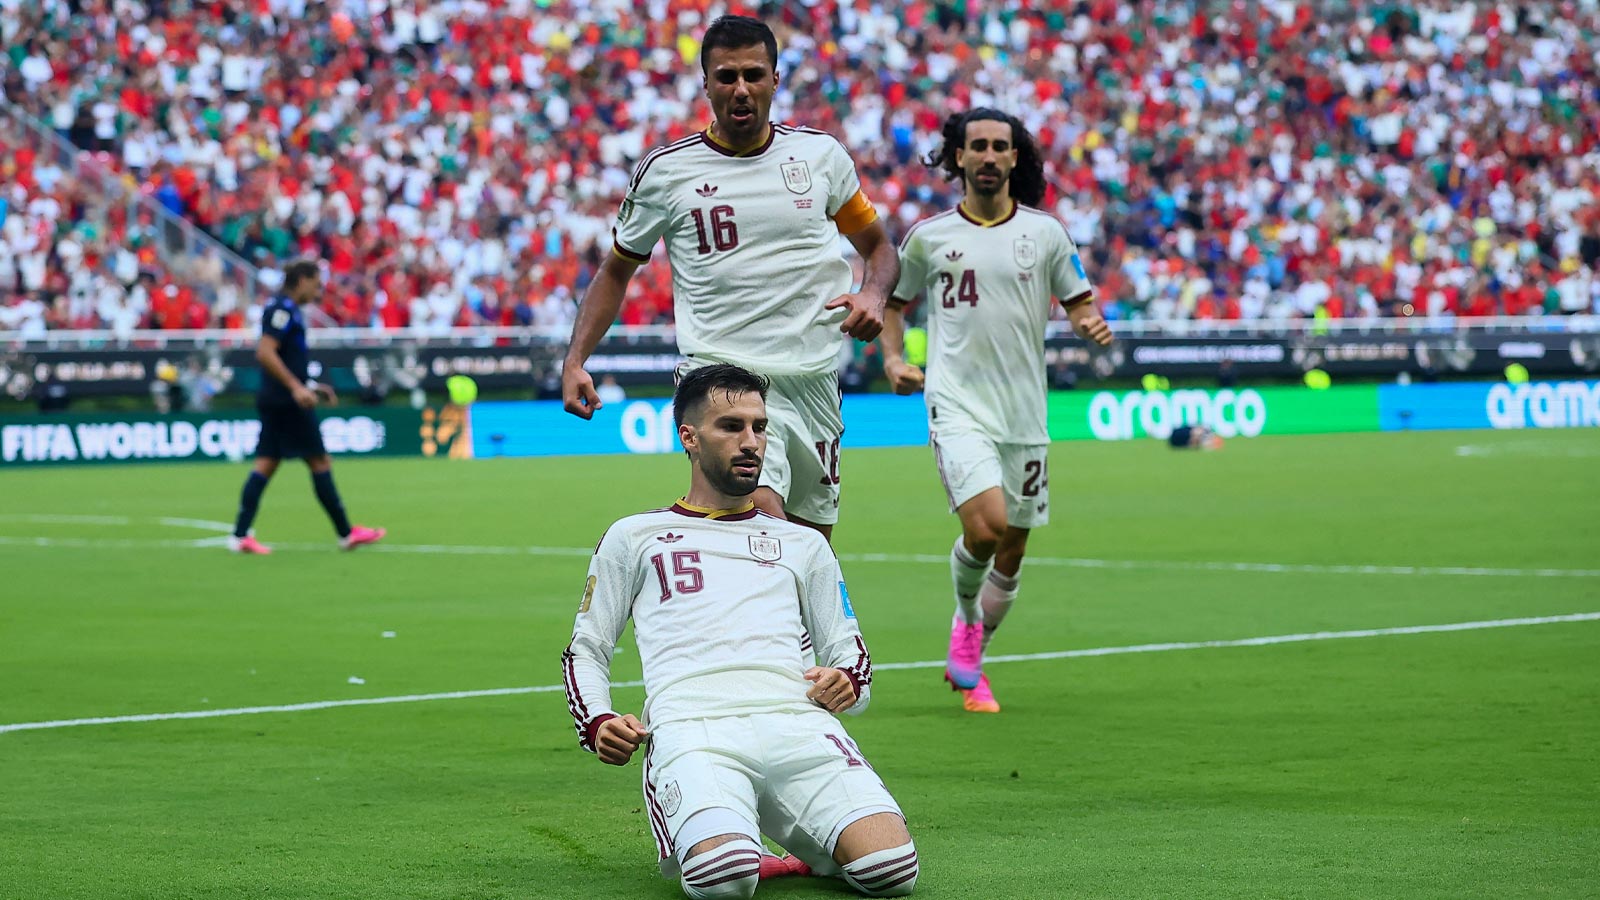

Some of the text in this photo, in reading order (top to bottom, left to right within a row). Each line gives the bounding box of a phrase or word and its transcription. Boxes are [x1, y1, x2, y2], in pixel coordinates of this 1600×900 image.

[690, 204, 739, 255] 16
[940, 269, 979, 309] 24
[1089, 388, 1267, 441] aramco
[1486, 381, 1600, 430] aram
[3, 424, 77, 461] FIFA
[76, 421, 197, 458] WORLD
[1022, 456, 1048, 497] 2
[650, 550, 705, 604] 15
[824, 733, 873, 770] 1
